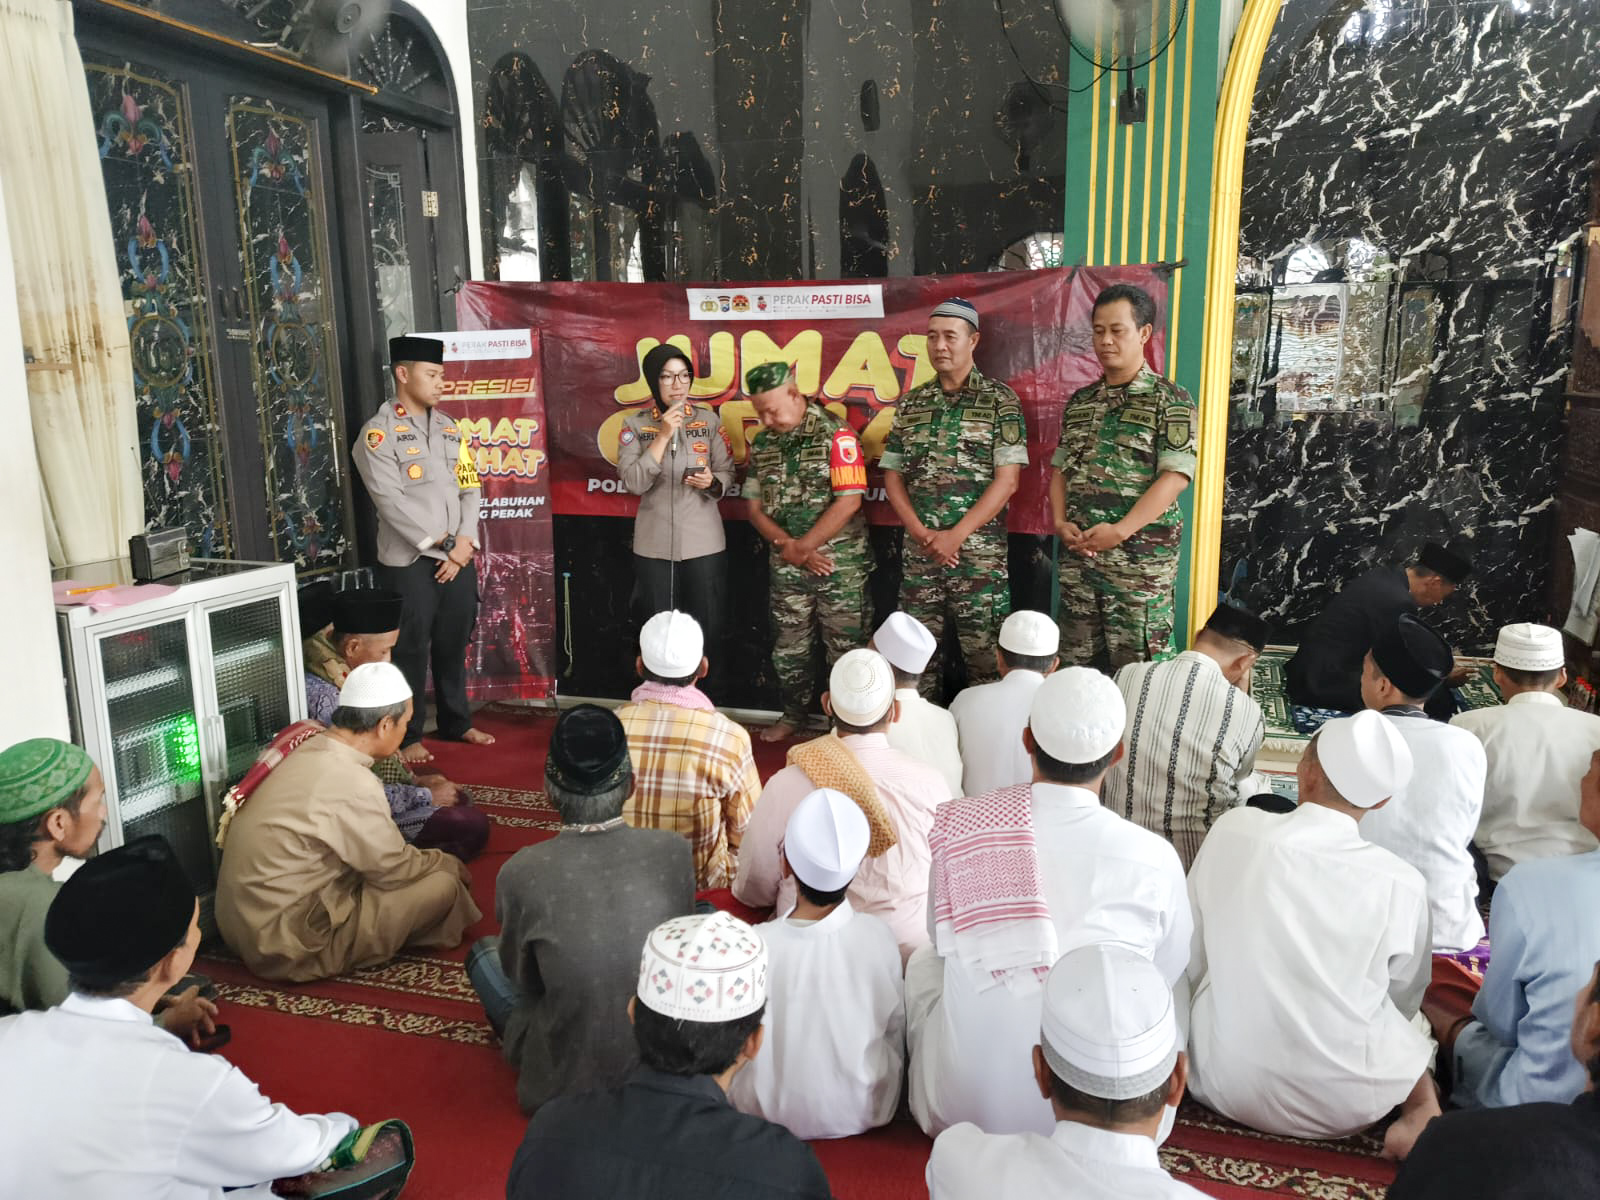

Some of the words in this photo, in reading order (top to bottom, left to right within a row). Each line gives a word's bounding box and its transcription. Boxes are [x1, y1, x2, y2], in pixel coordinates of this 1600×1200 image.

[773, 295, 811, 305] PERAK
[811, 294, 843, 305] PASTI
[845, 293, 872, 304] BISA
[461, 341, 487, 349] PERAK
[487, 340, 509, 348] PASTI
[510, 339, 527, 347] BISA
[460, 417, 539, 447] MAT
[686, 429, 710, 438] POLRI
[479, 496, 545, 508] ELABUHAN
[491, 508, 534, 519] PERAK
